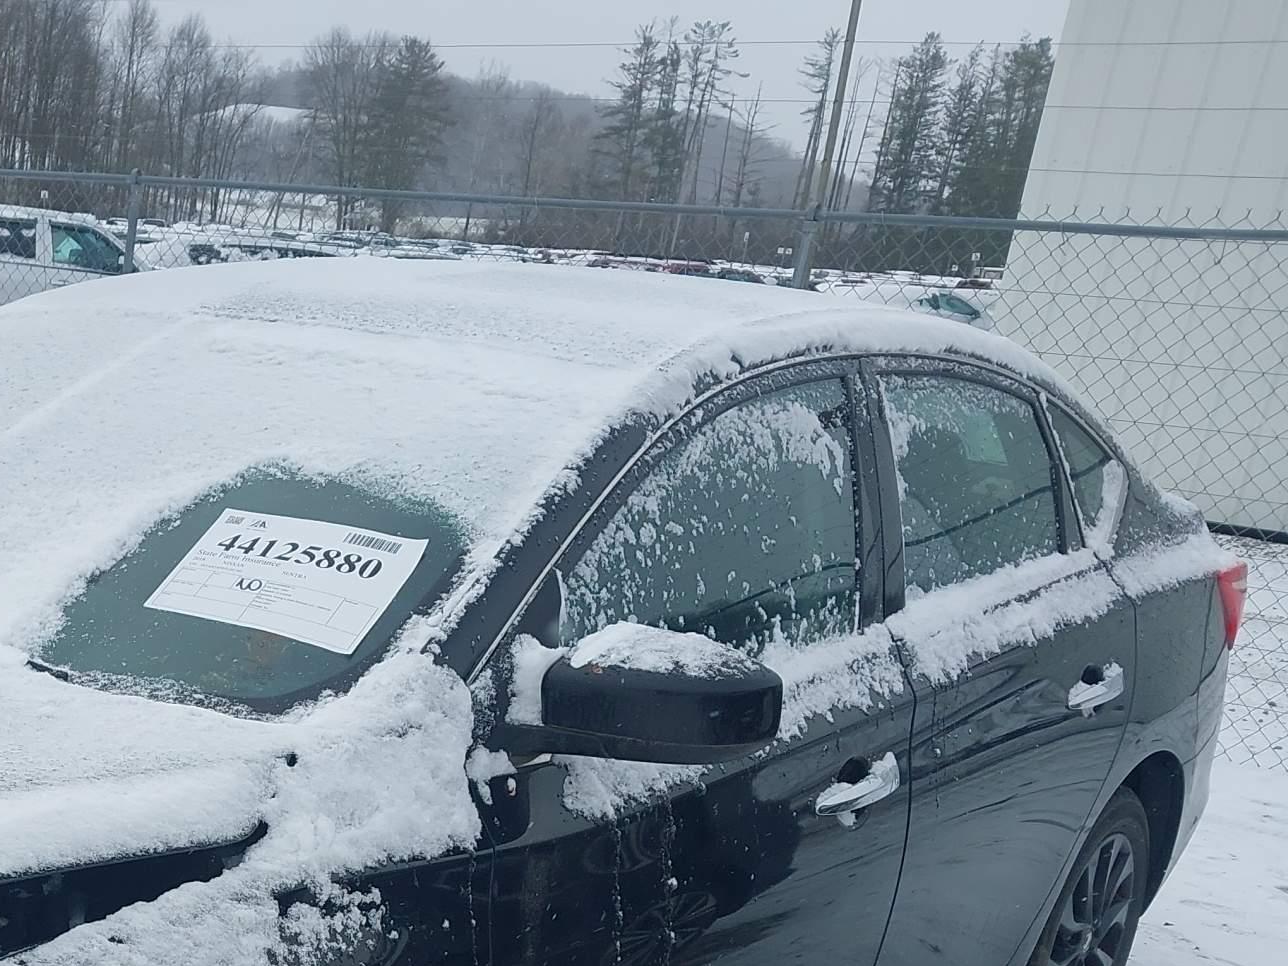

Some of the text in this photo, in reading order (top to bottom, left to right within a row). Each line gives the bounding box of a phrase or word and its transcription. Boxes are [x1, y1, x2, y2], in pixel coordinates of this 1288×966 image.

[198, 549, 218, 557] State
[218, 551, 240, 560] Farm
[241, 554, 282, 567] Insurance
[216, 533, 383, 579] 44125880
